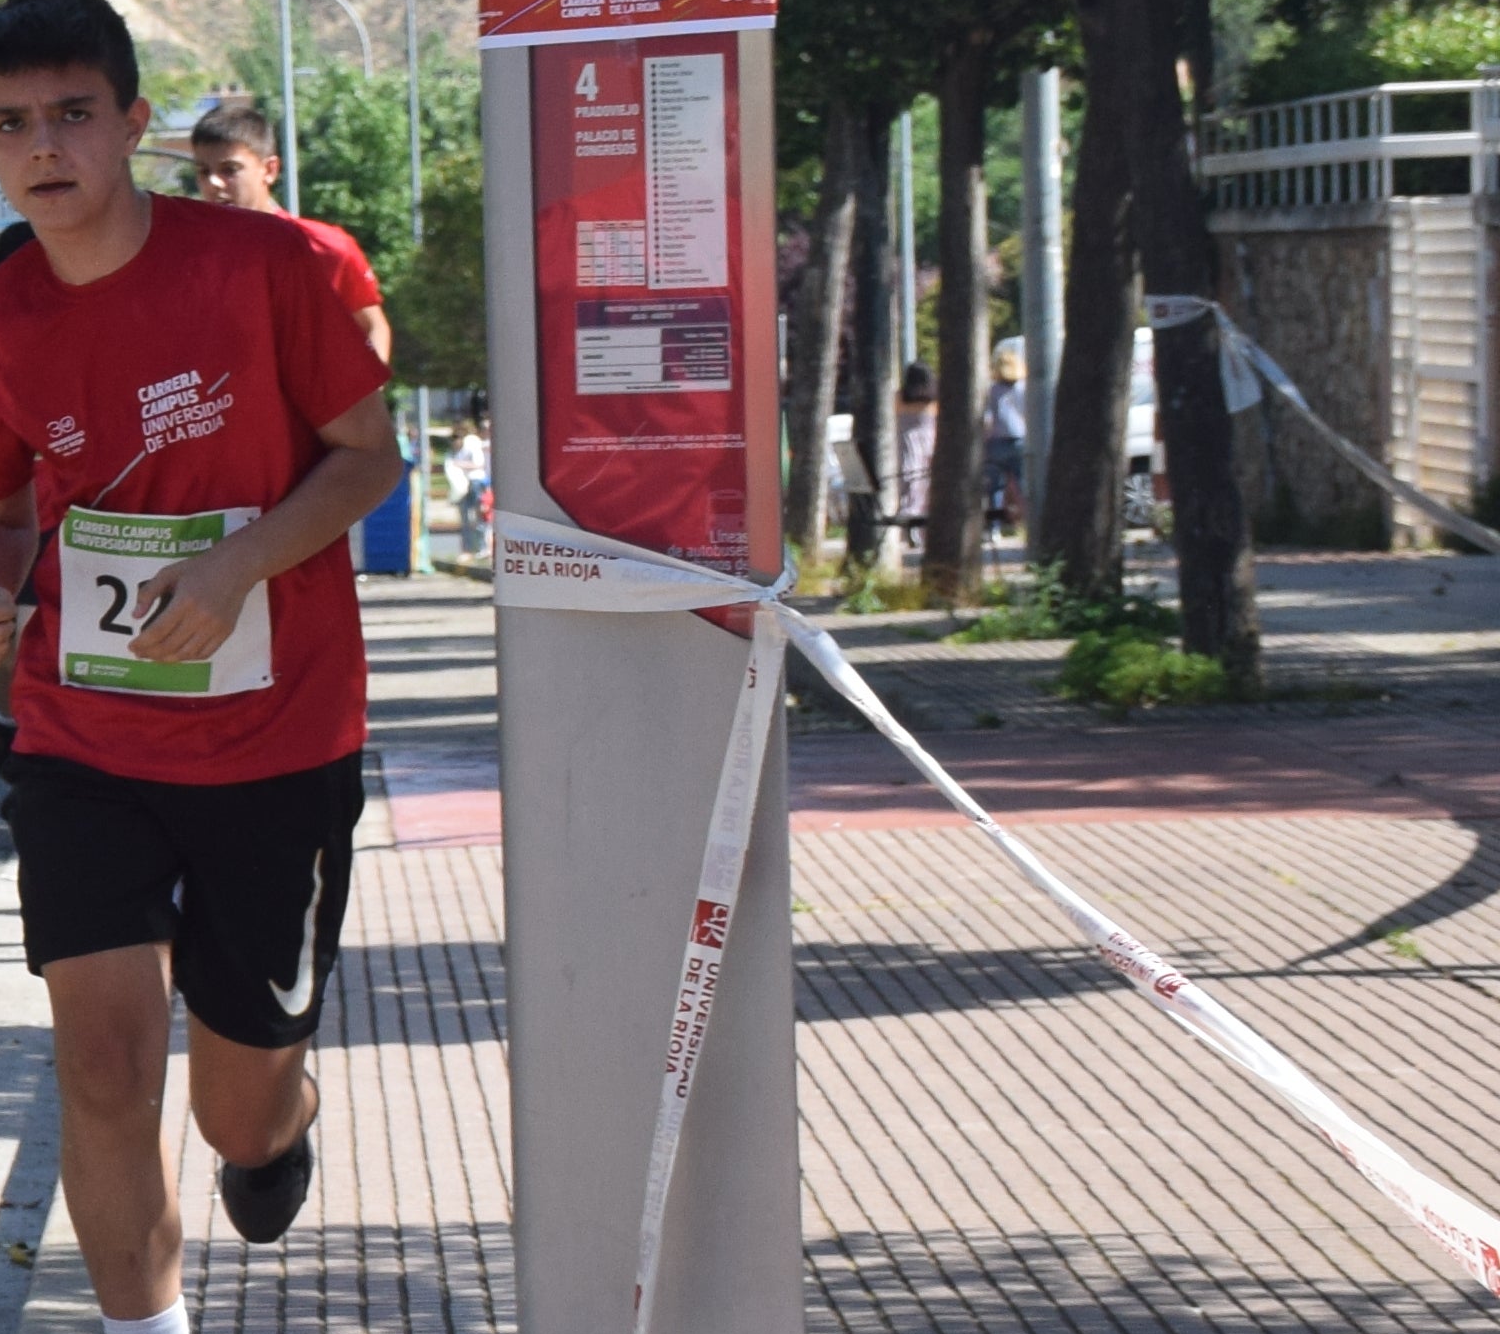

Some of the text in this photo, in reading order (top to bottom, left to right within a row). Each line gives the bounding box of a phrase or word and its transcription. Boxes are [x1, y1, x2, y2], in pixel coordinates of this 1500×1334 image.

[561, 6, 602, 18] CAMPUS
[575, 62, 599, 101] 4
[576, 128, 637, 143] PALACIO DE
[576, 142, 638, 157] CONGRESOS
[137, 369, 203, 403] CARRERA
[141, 388, 200, 419] CAMPUS
[142, 393, 234, 436] UNIVERSIDAD
[145, 414, 226, 454] DE LA RIOJA
[72, 519, 172, 540] CARRERA CAMPUS
[71, 532, 213, 554] UNIVERSIDAD DE LA RIOJA
[504, 560, 524, 575] DE
[528, 560, 550, 577] LA
[554, 562, 602, 582] RIOJA
[665, 956, 704, 1075] DE LA RIOJA
